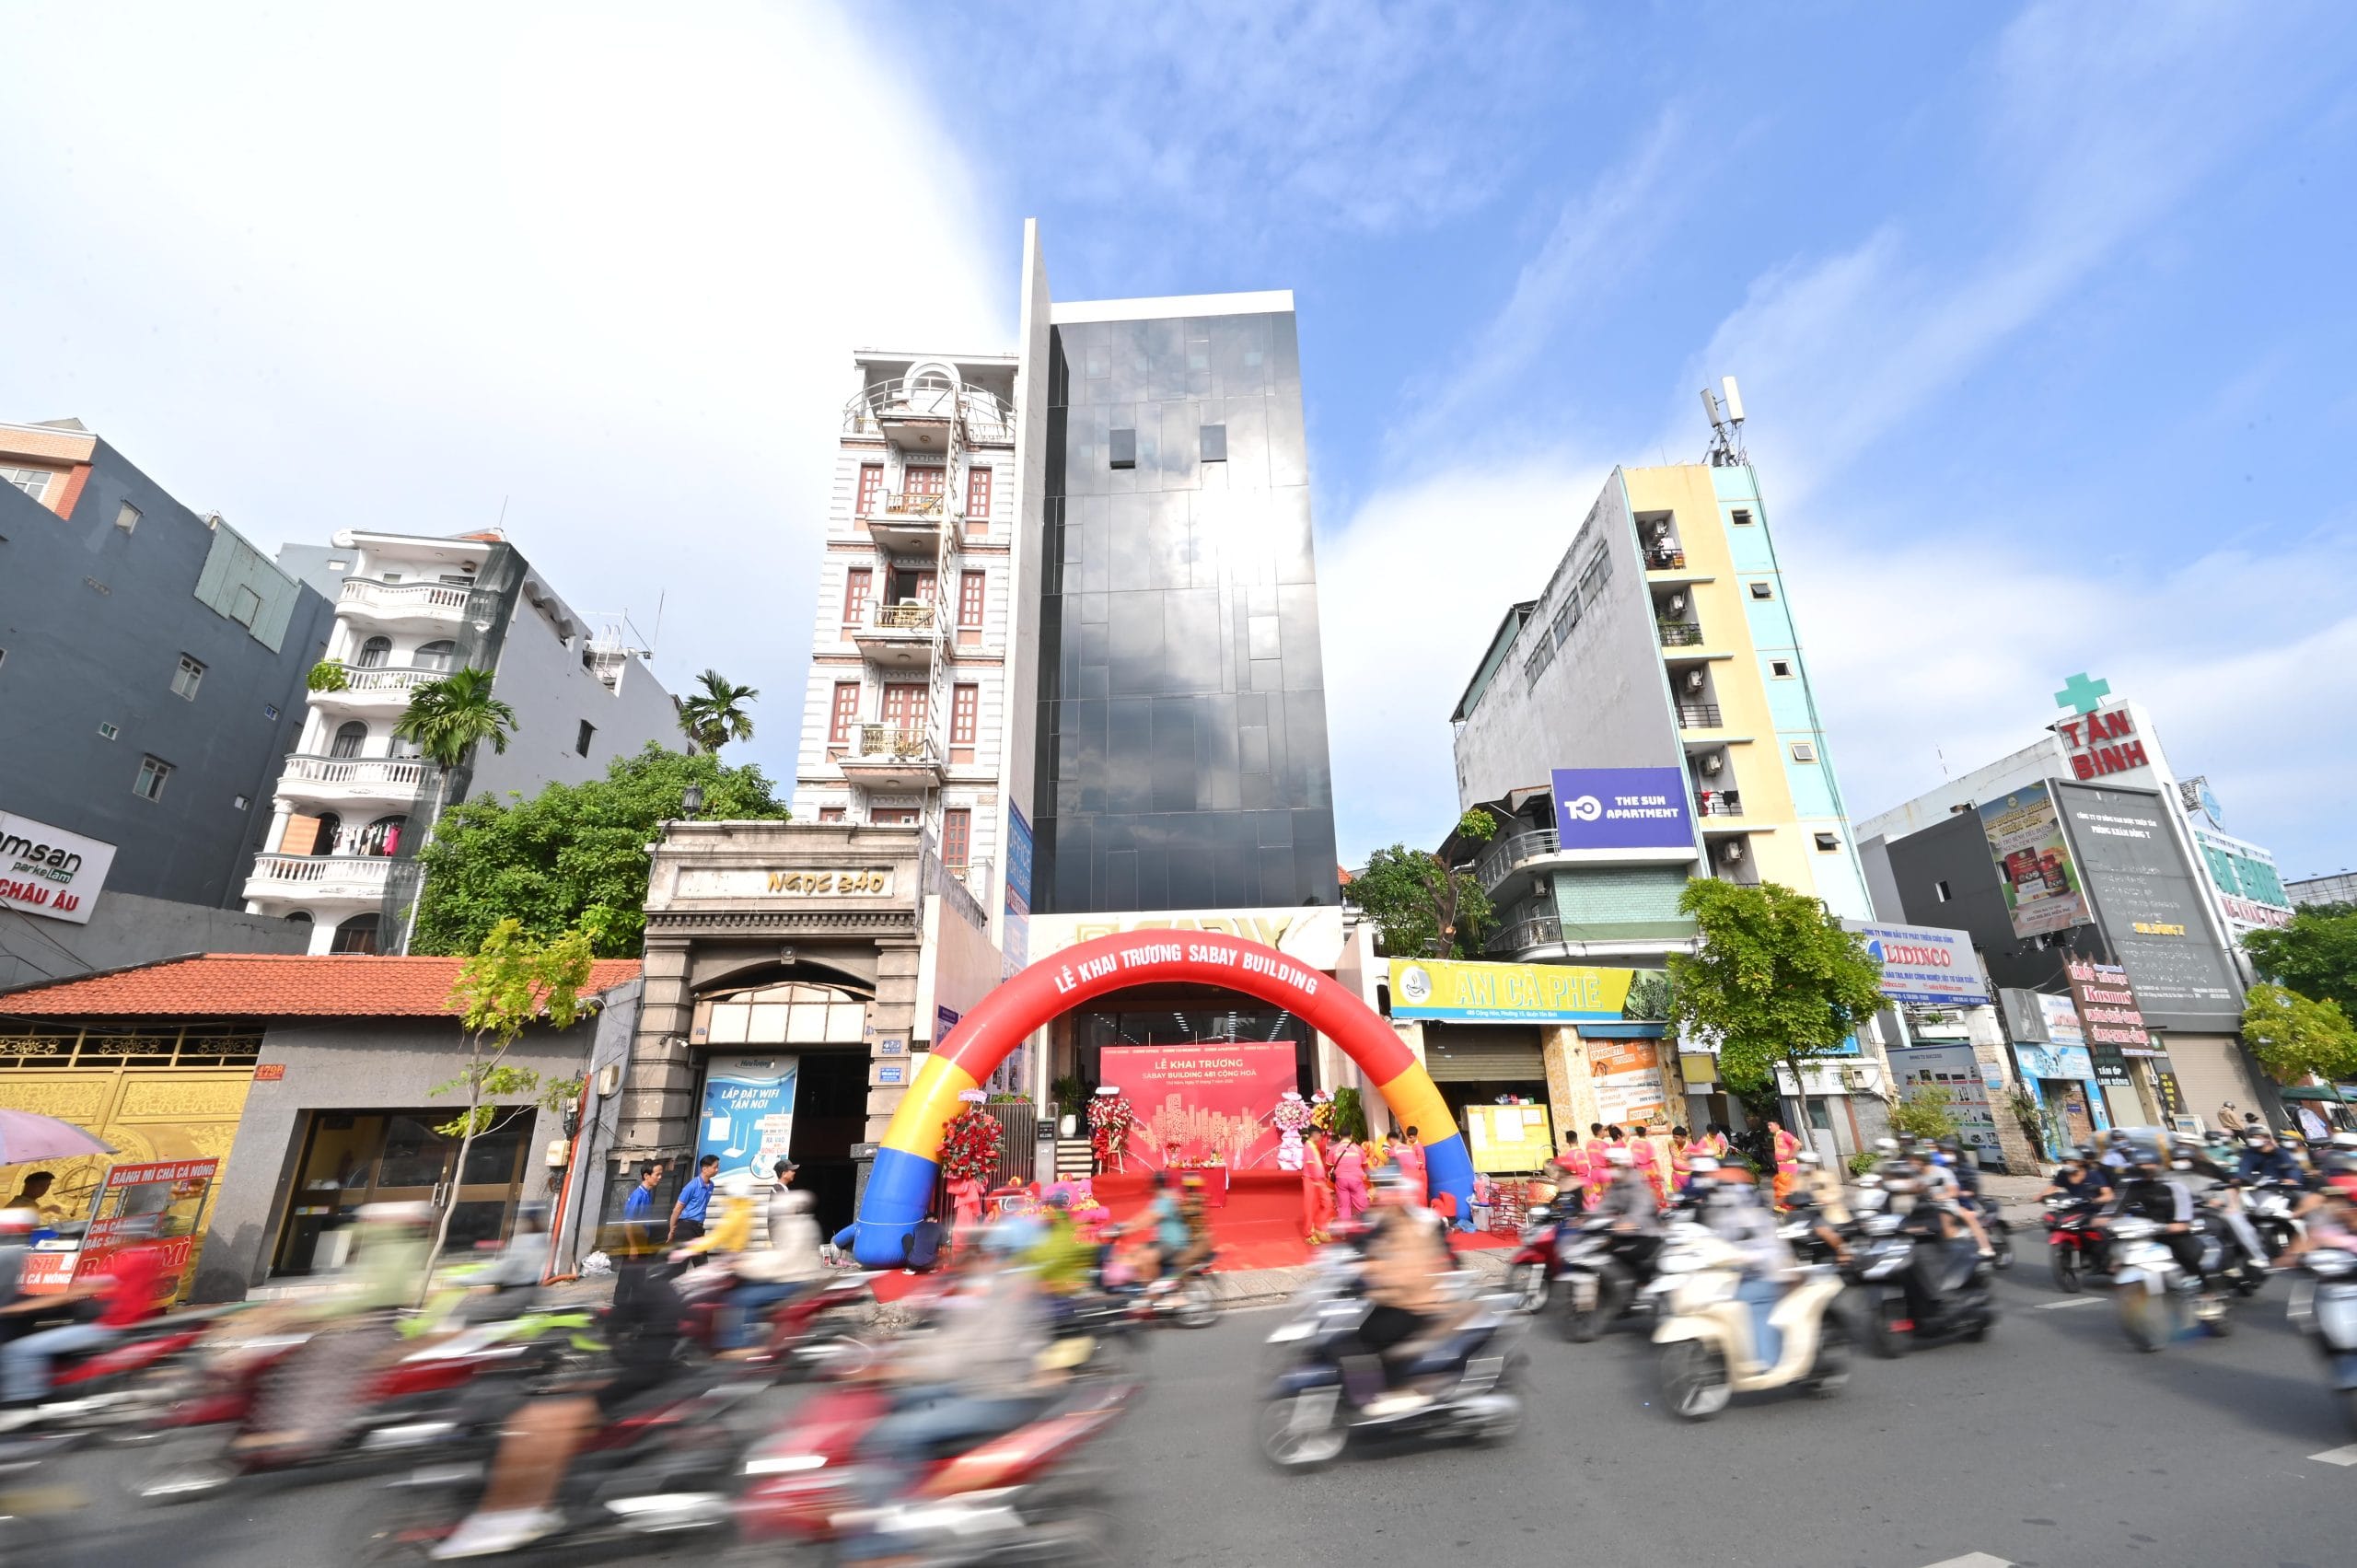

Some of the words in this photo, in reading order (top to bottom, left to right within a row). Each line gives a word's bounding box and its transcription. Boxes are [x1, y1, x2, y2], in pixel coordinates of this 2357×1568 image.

[2061, 709, 2131, 748] TÂN
[2071, 739, 2150, 781] BÌNH
[1615, 796, 1639, 806] THE
[1641, 796, 1666, 806] SUN
[1606, 808, 1678, 819] APARTMENT
[1008, 827, 1032, 873] OFFICE
[0, 878, 50, 905] CHÂU
[52, 889, 80, 912] ÂU
[1883, 944, 1950, 967] LIDINCO
[1054, 965, 1078, 994] LỄ
[1079, 953, 1118, 983] KHAI
[1120, 944, 1181, 969] TRƯƠNG
[1189, 944, 1237, 967] SABAY
[1242, 952, 1318, 995] BUILDING
[1453, 970, 1496, 1005] AN
[1502, 968, 1543, 1007] CÀ
[1547, 972, 1603, 1008] PHÊ
[1155, 1058, 1167, 1069] LỄ
[1170, 1061, 1195, 1069] KHAI
[1199, 1059, 1243, 1068] TRƯƠNG
[722, 1086, 739, 1098] LẮP
[740, 1088, 758, 1099] ĐẶT
[759, 1088, 780, 1098] WIFI
[731, 1098, 749, 1110] TẬN
[750, 1099, 769, 1109] NƠI
[1630, 1111, 1640, 1120] HOT
[111, 1171, 139, 1185] BÁNH
[143, 1167, 156, 1182] MÌ
[156, 1166, 175, 1179] CHẢ
[177, 1165, 190, 1179] CÁ
[190, 1163, 215, 1178] NÓNG
[89, 1220, 108, 1235] CHẢ
[27, 1271, 41, 1284] CÁ
[42, 1271, 73, 1284] NÓNG
